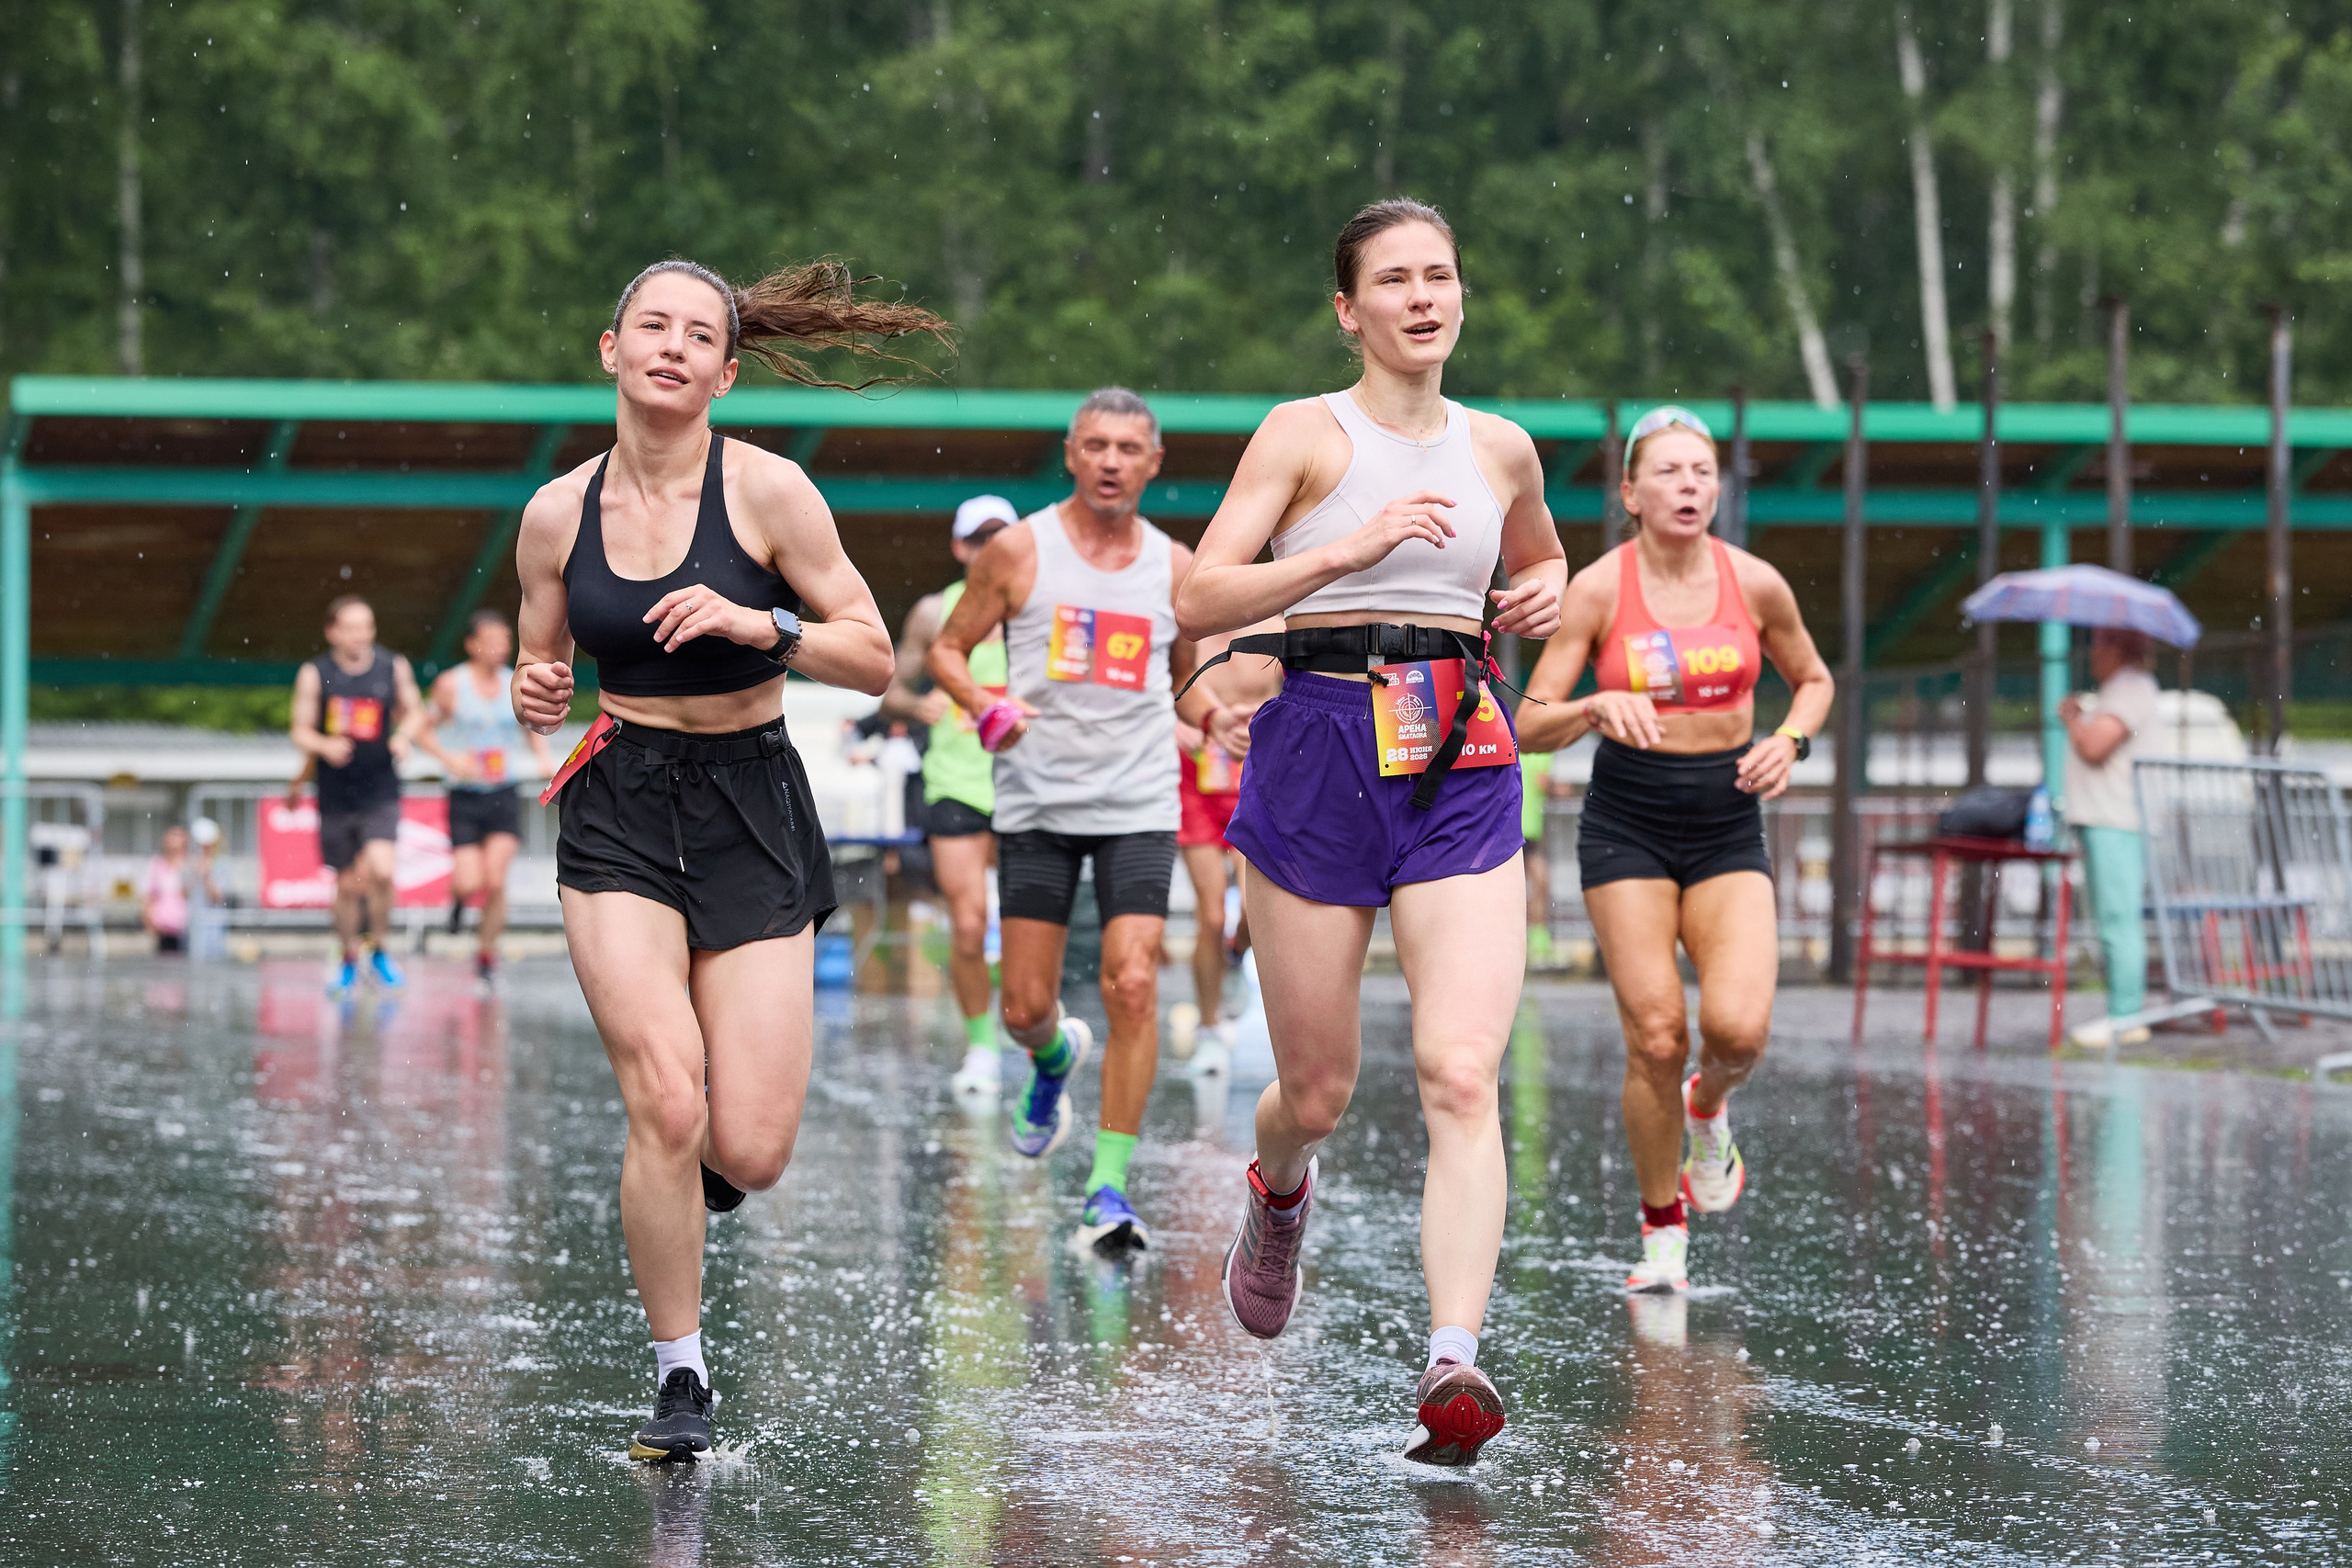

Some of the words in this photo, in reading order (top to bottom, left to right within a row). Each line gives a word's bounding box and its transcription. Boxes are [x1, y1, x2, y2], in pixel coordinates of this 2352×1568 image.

[1106, 631, 1145, 660] 67
[1682, 644, 1740, 676] 109
[1398, 723, 1427, 734] АРЕНА
[1386, 748, 1408, 762] 28
[1462, 743, 1476, 756] 10
